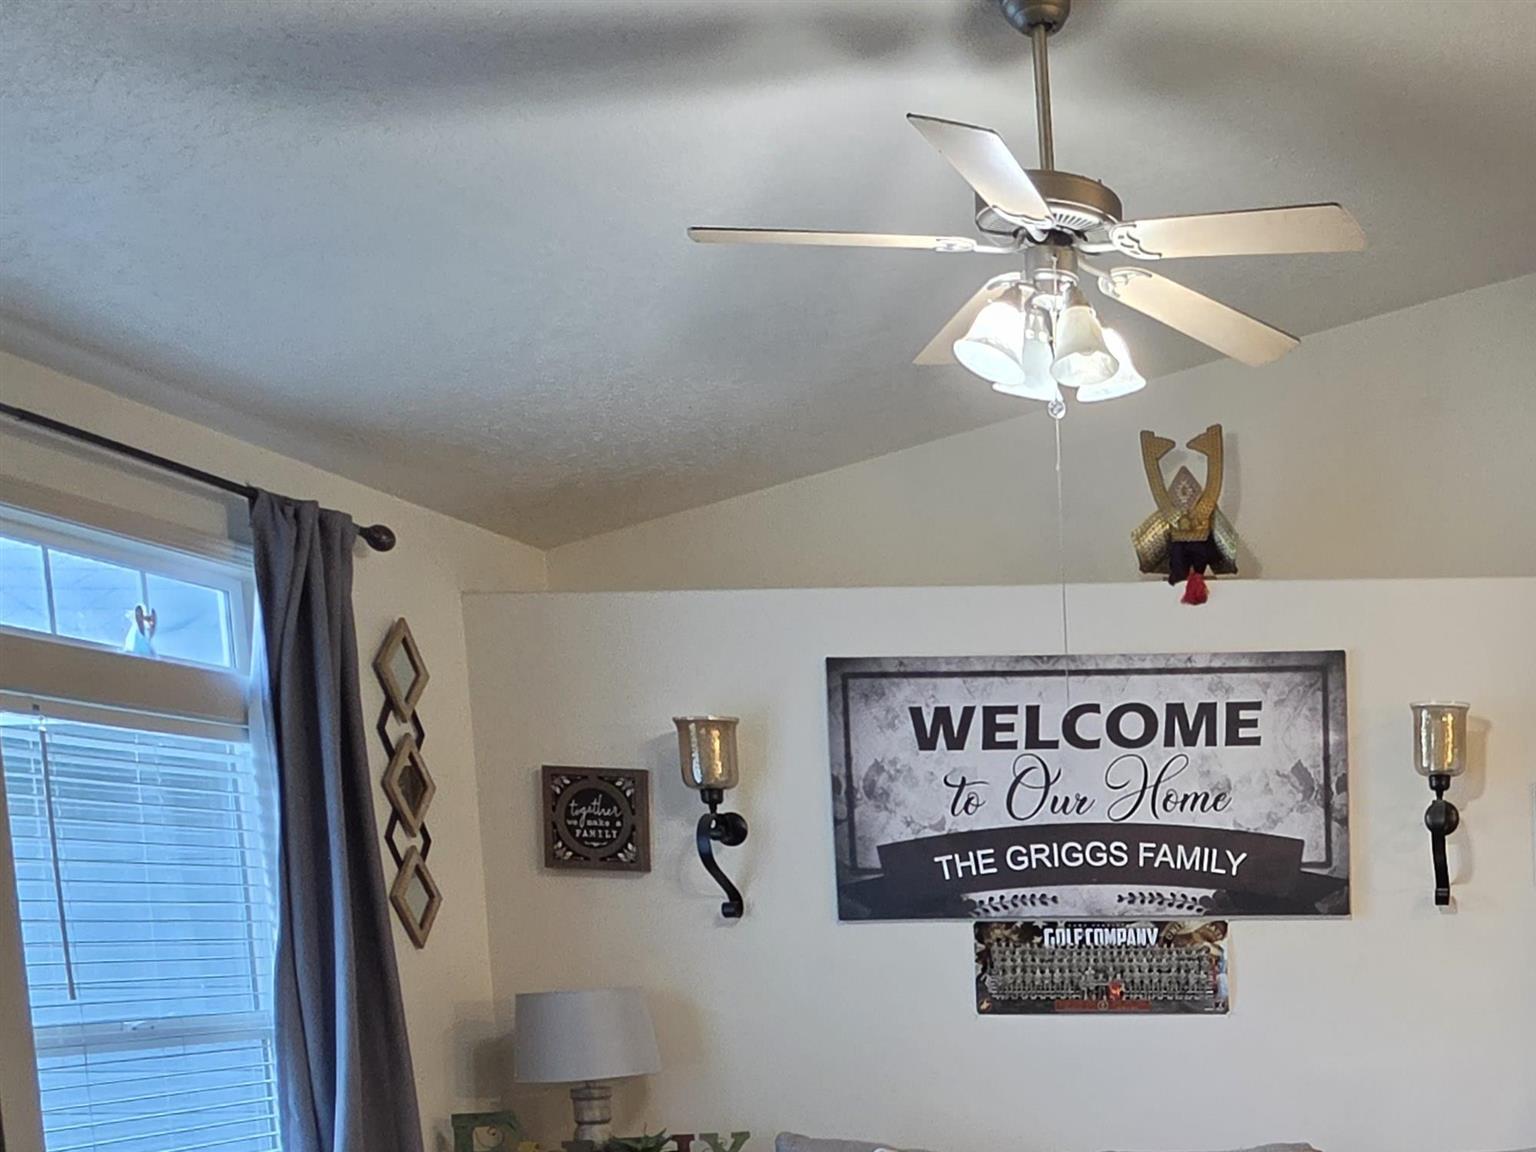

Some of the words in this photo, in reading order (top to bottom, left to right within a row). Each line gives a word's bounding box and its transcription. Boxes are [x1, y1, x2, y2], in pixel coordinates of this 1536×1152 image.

[908, 700, 1263, 752] WELCOME
[944, 774, 990, 817] to
[1005, 752, 1096, 821] Our
[1104, 752, 1232, 822] Home
[569, 794, 622, 828] together
[575, 829, 617, 838] FAMILY
[934, 848, 998, 880] THE
[1006, 841, 1128, 870] GRIGGS
[1138, 841, 1247, 877] FAMILY
